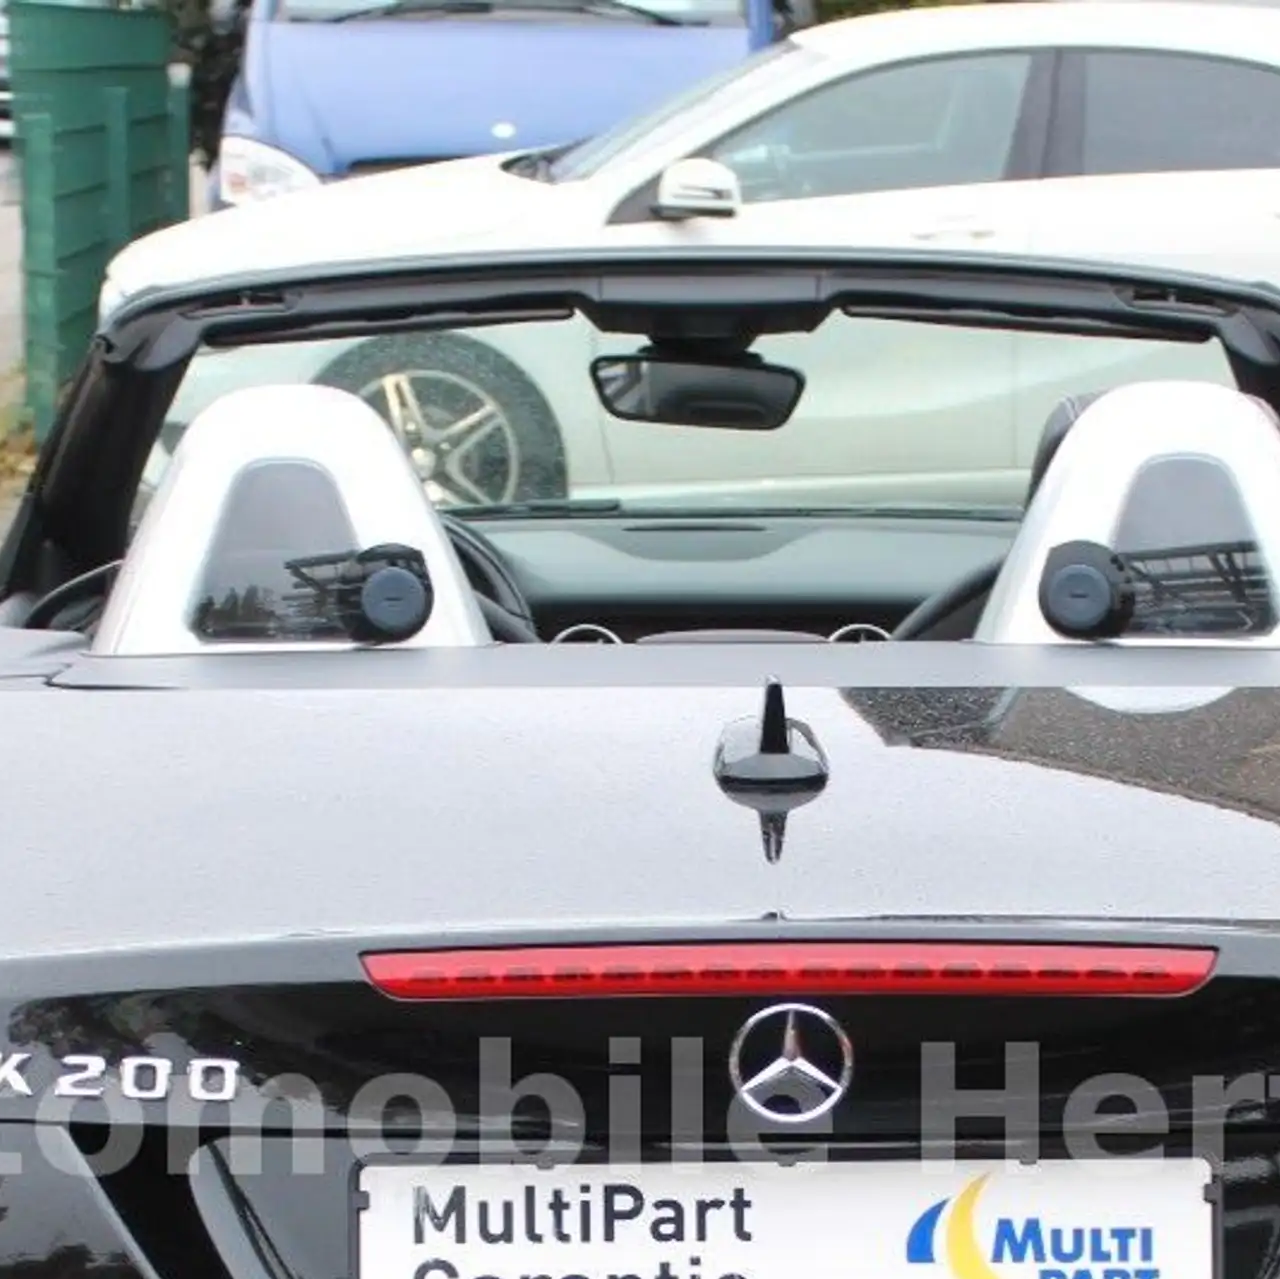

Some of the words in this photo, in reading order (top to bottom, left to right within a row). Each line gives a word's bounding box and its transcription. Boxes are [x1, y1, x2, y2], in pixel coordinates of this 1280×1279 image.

[55, 1056, 242, 1102] 200
[412, 1184, 753, 1246] MultiPart
[991, 1217, 1154, 1264] MULTI
